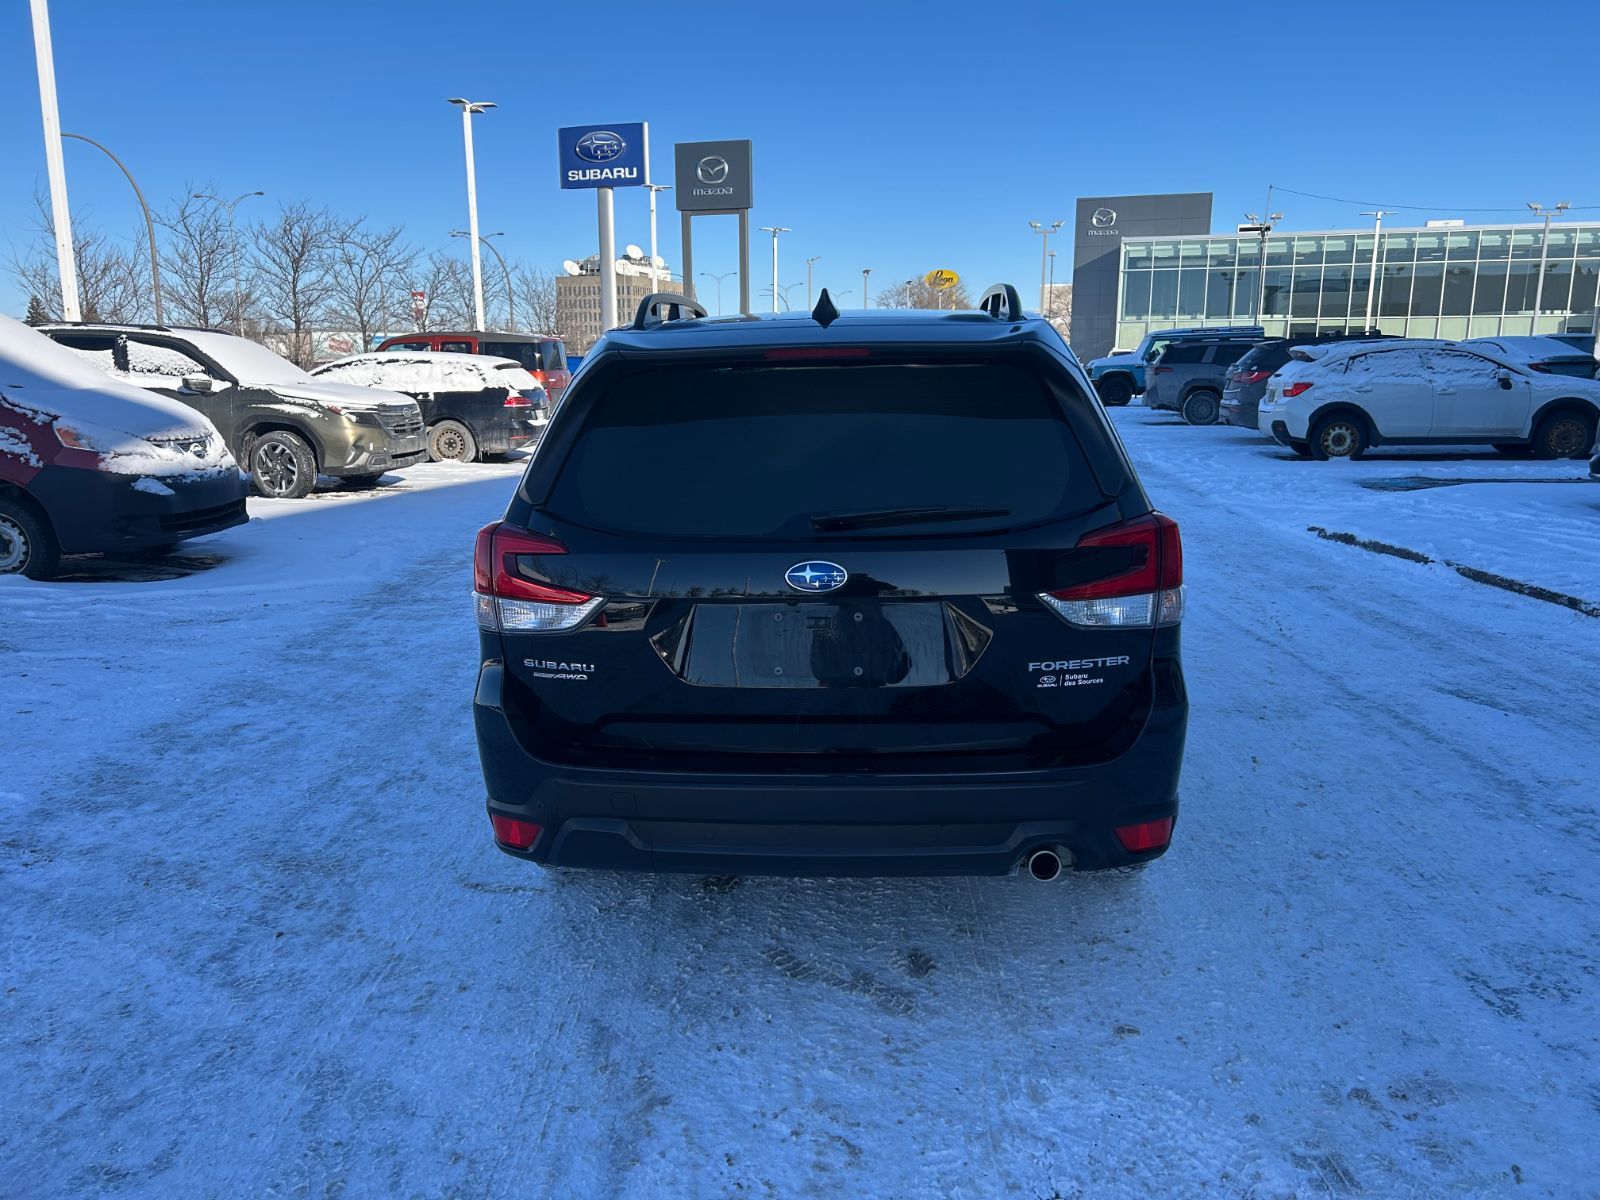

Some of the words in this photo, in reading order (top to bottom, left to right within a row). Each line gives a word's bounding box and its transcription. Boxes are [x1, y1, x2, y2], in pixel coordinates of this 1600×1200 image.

[568, 167, 637, 181] SUBARU
[692, 187, 734, 197] mazda
[523, 659, 595, 672] SUBARU
[1028, 655, 1130, 671] FORESTER
[1077, 678, 1104, 686] Sources
